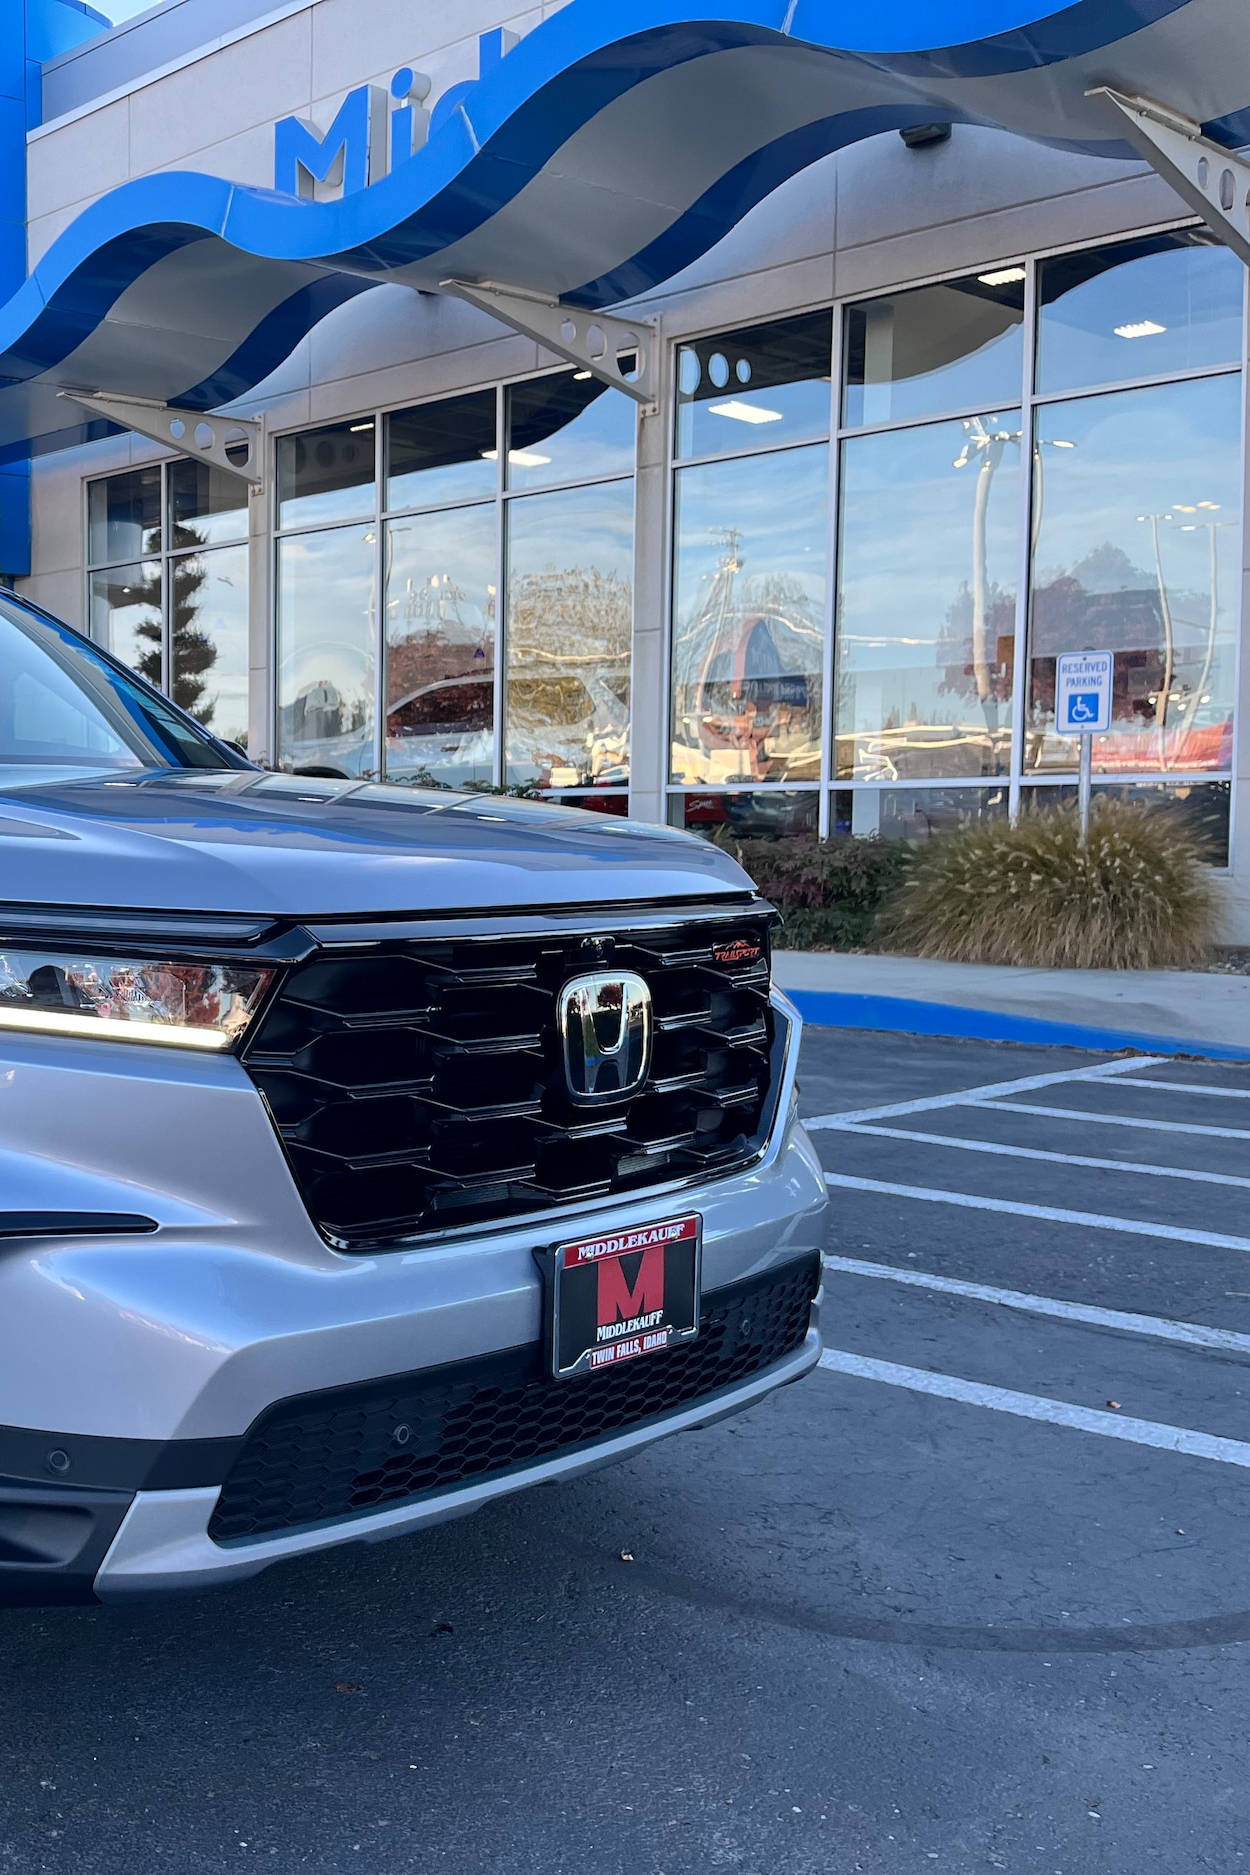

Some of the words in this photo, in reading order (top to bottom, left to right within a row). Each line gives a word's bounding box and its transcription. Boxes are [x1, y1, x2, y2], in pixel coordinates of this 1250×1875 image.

[1061, 661, 1108, 674] RESERVED
[1066, 675, 1103, 688] PARKING
[577, 1223, 685, 1260] MIDDLEKAUFF
[597, 1245, 665, 1326] M
[596, 1309, 664, 1342] MIDDLEKAUFF
[592, 1345, 615, 1365] TWIN
[616, 1338, 642, 1358] FALLS,
[643, 1331, 667, 1350] IDAHO
